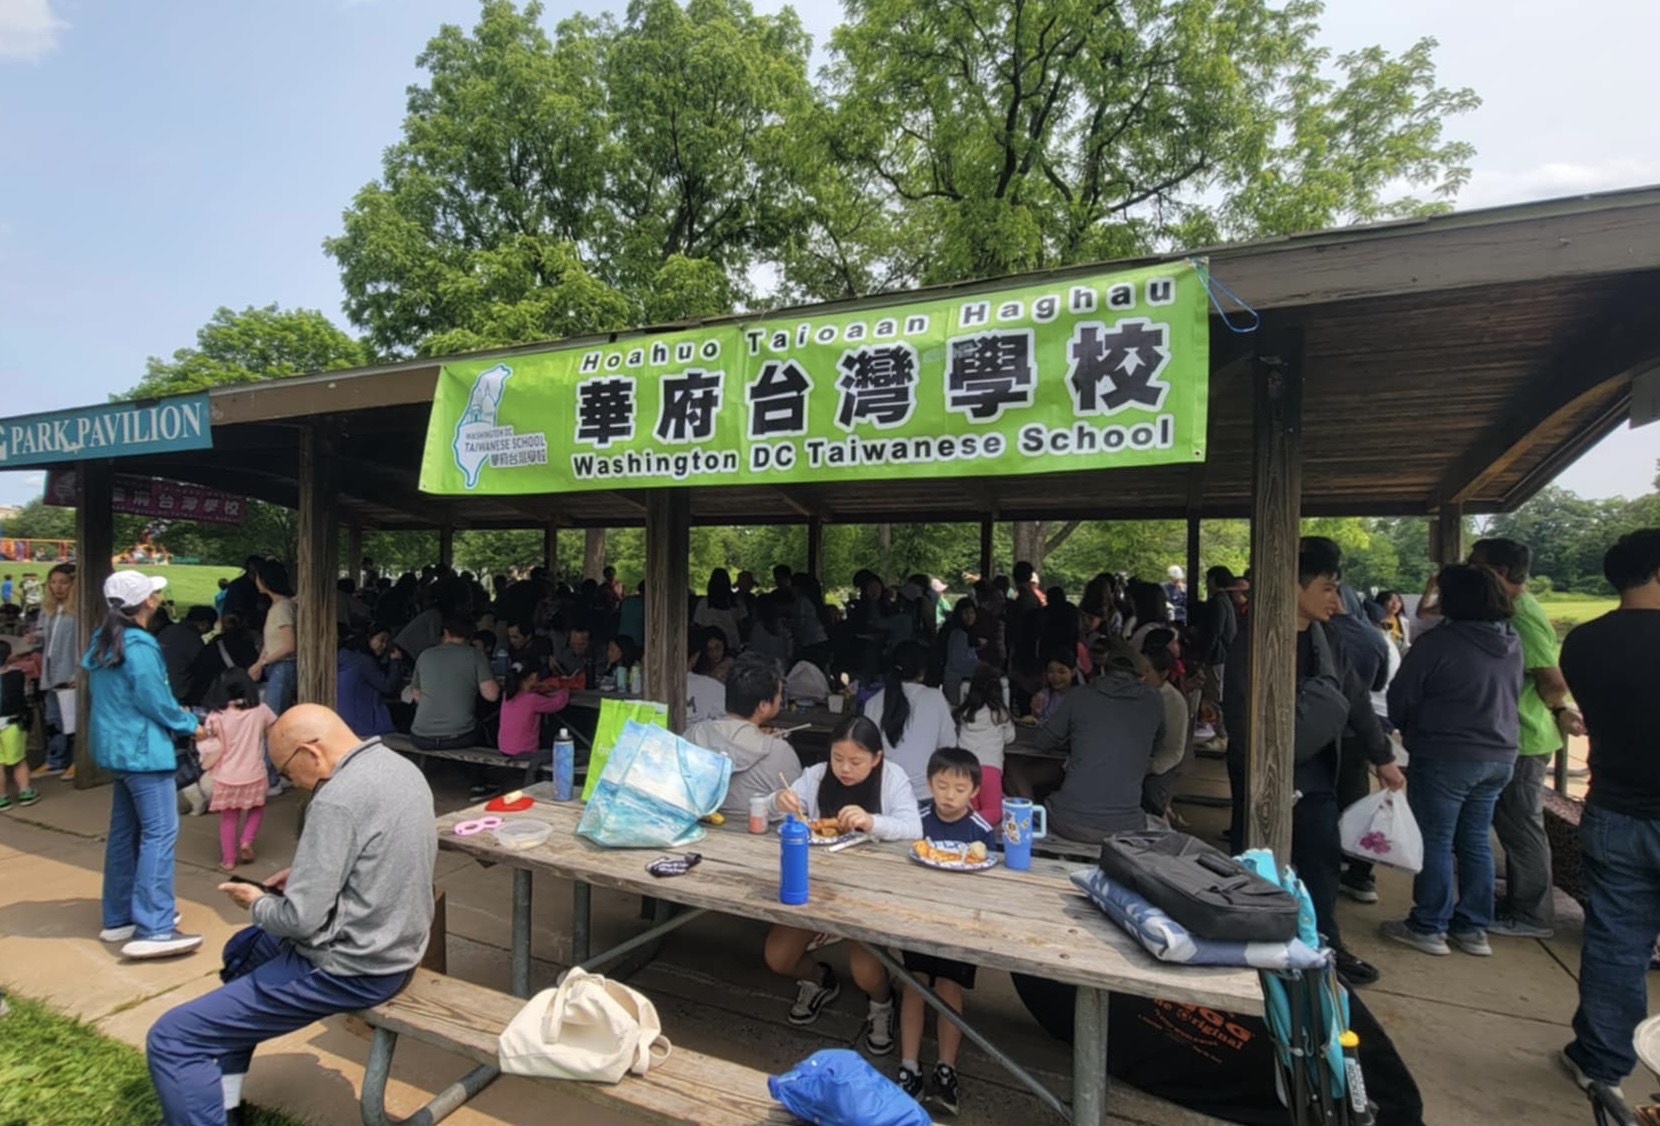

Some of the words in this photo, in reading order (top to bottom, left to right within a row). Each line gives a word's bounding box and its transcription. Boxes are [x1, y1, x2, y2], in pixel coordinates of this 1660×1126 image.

[581, 338, 720, 371] Hoahuo
[747, 315, 927, 355] Taioaan
[962, 280, 1173, 326] Haghau
[577, 321, 1165, 445] 華府台灣學校
[11, 420, 72, 455] PARK
[78, 402, 202, 449] PAVILION
[464, 439, 510, 452] TAIWANESE
[511, 434, 546, 448] SCHOOL
[573, 450, 738, 478] Washington
[753, 444, 794, 469] DC
[806, 432, 1002, 465] Taiwanese
[1021, 417, 1170, 453] School
